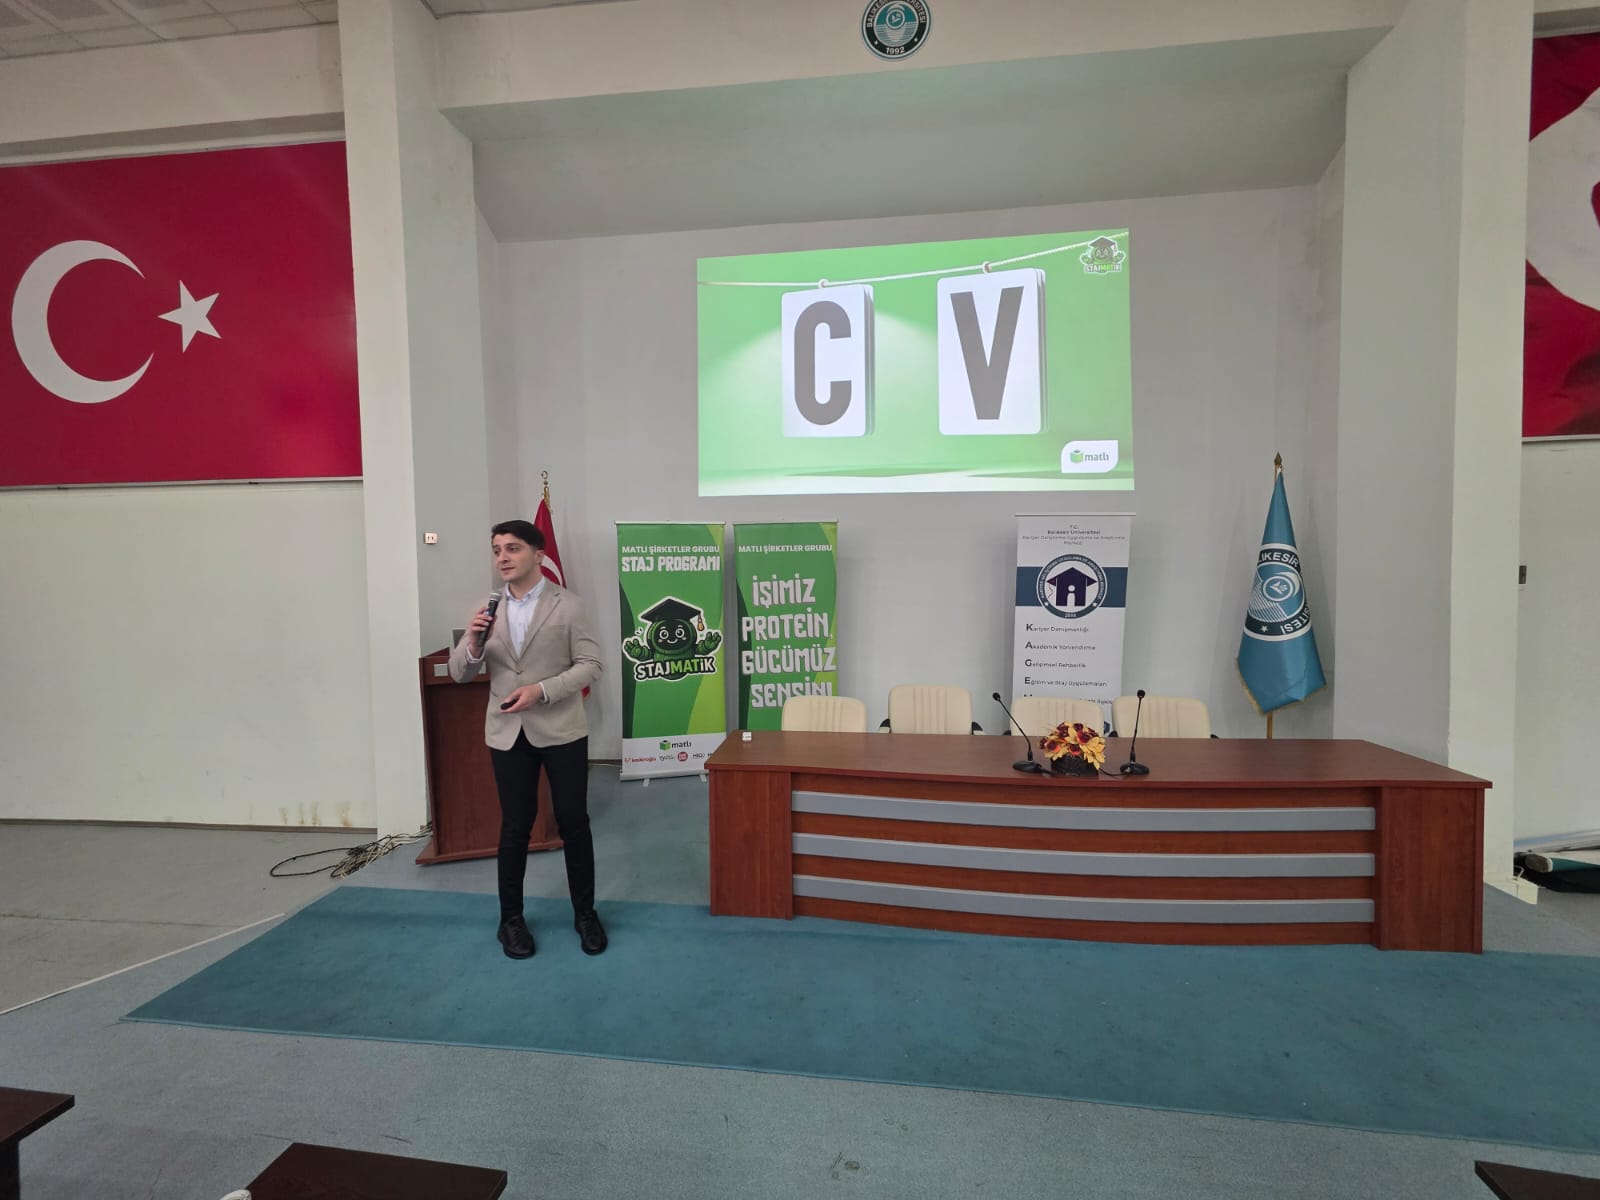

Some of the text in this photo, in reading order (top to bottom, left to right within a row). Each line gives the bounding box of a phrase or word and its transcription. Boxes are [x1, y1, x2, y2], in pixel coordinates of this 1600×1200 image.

[886, 47, 905, 55] 1992
[649, 544, 691, 554] ŞİRKETLER
[692, 545, 720, 553] GRUBU
[738, 544, 833, 555] MATLI ŞİRKETLER GRUBU
[622, 555, 720, 572] STAJ PROGRAMI
[752, 573, 816, 608] İŞİMİZ
[741, 644, 836, 675] GÜCÜMÜZ
